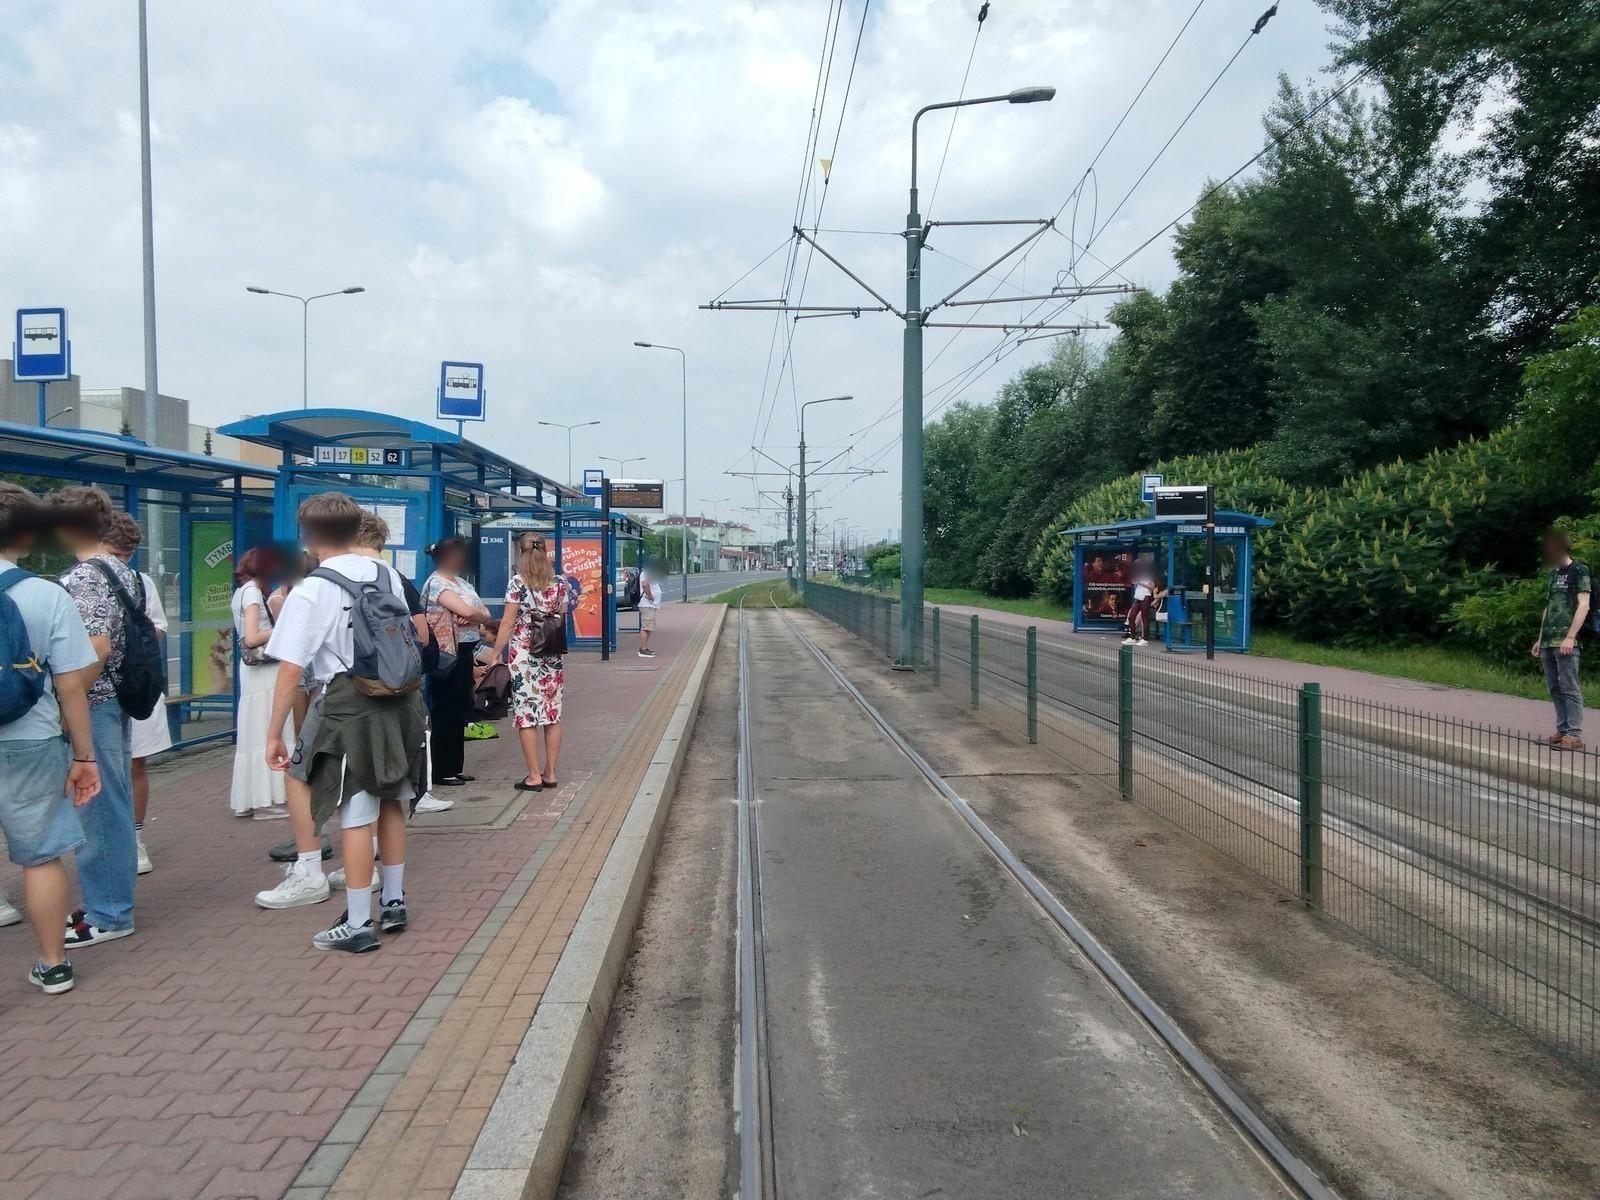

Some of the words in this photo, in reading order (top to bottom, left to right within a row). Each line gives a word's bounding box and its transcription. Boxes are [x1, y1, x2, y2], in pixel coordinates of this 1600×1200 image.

[322, 451, 330, 460] 11
[338, 451, 347, 460] 17
[354, 452, 364, 461] 18
[371, 452, 380, 462] 52
[387, 452, 398, 462] 62
